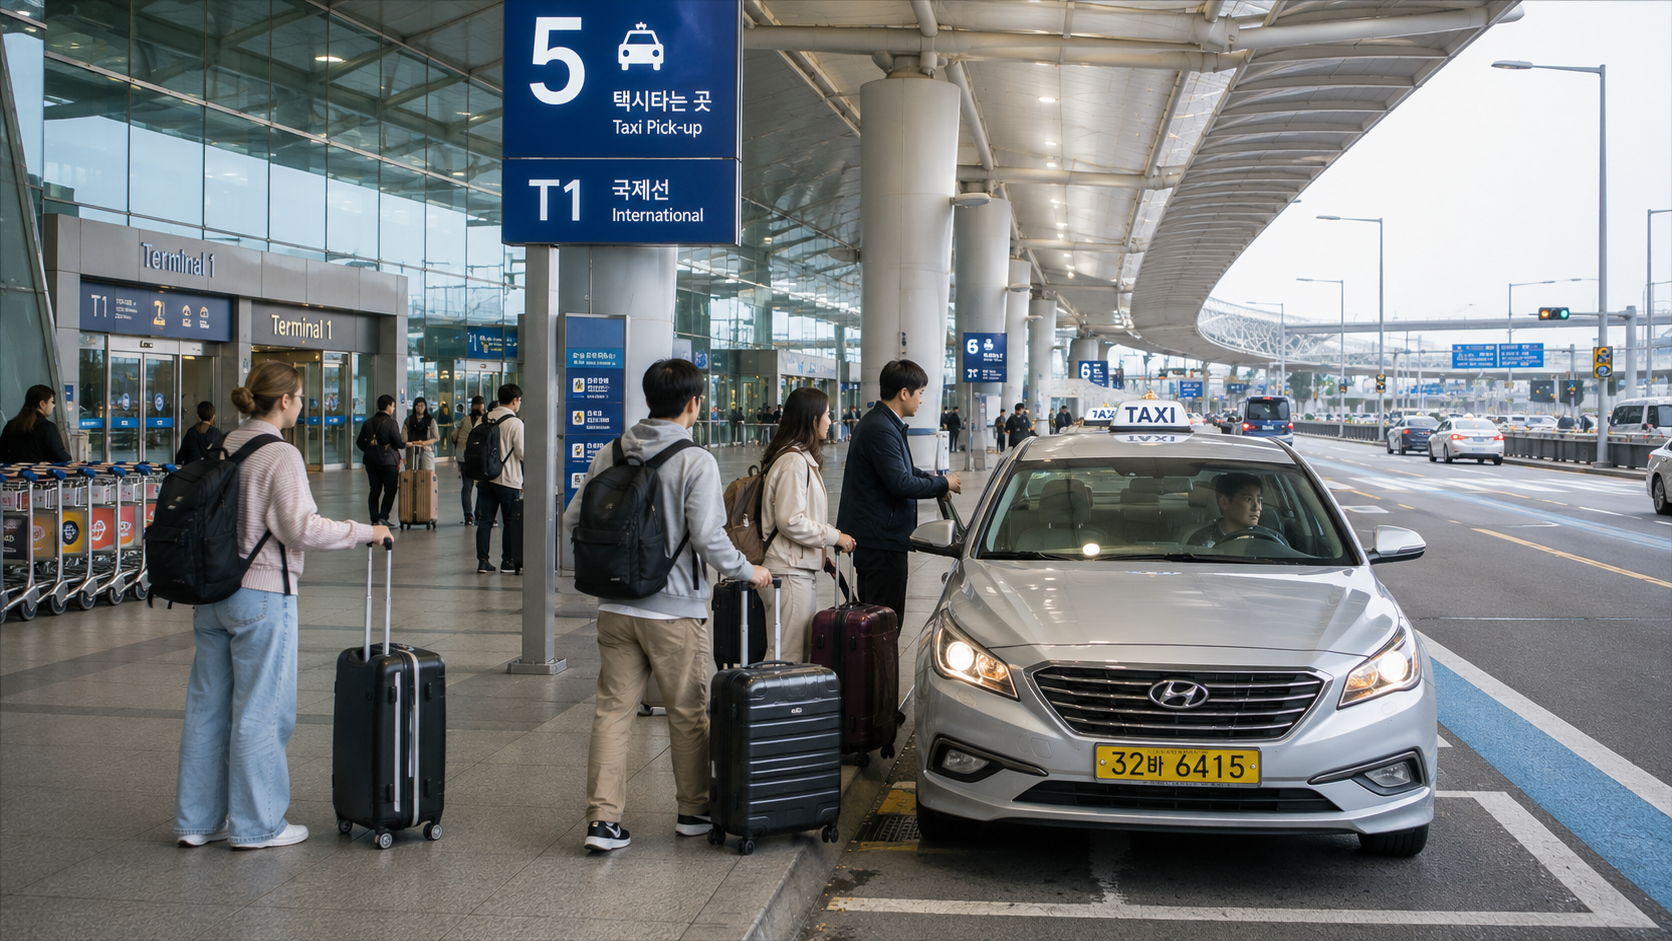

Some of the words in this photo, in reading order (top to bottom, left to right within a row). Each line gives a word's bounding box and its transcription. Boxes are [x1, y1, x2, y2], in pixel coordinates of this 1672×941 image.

[529, 16, 586, 105] 5
[613, 90, 688, 112] 택시타는
[693, 90, 712, 112] 곳
[612, 119, 642, 135] Taxi
[647, 119, 702, 138] Pick-up
[528, 179, 581, 221] T1
[612, 179, 669, 201] 국제선
[612, 207, 704, 222] International
[141, 241, 205, 277] Terminal
[209, 253, 215, 278] 1
[91, 294, 108, 318] T1
[270, 313, 323, 339] Terminal
[326, 319, 332, 340] 1
[967, 339, 979, 354] 6
[1080, 363, 1091, 379] 6
[1092, 410, 1115, 419] TAX
[1124, 406, 1176, 424] TAXI
[1111, 751, 1164, 777] 32바
[1175, 754, 1245, 779] 6415
